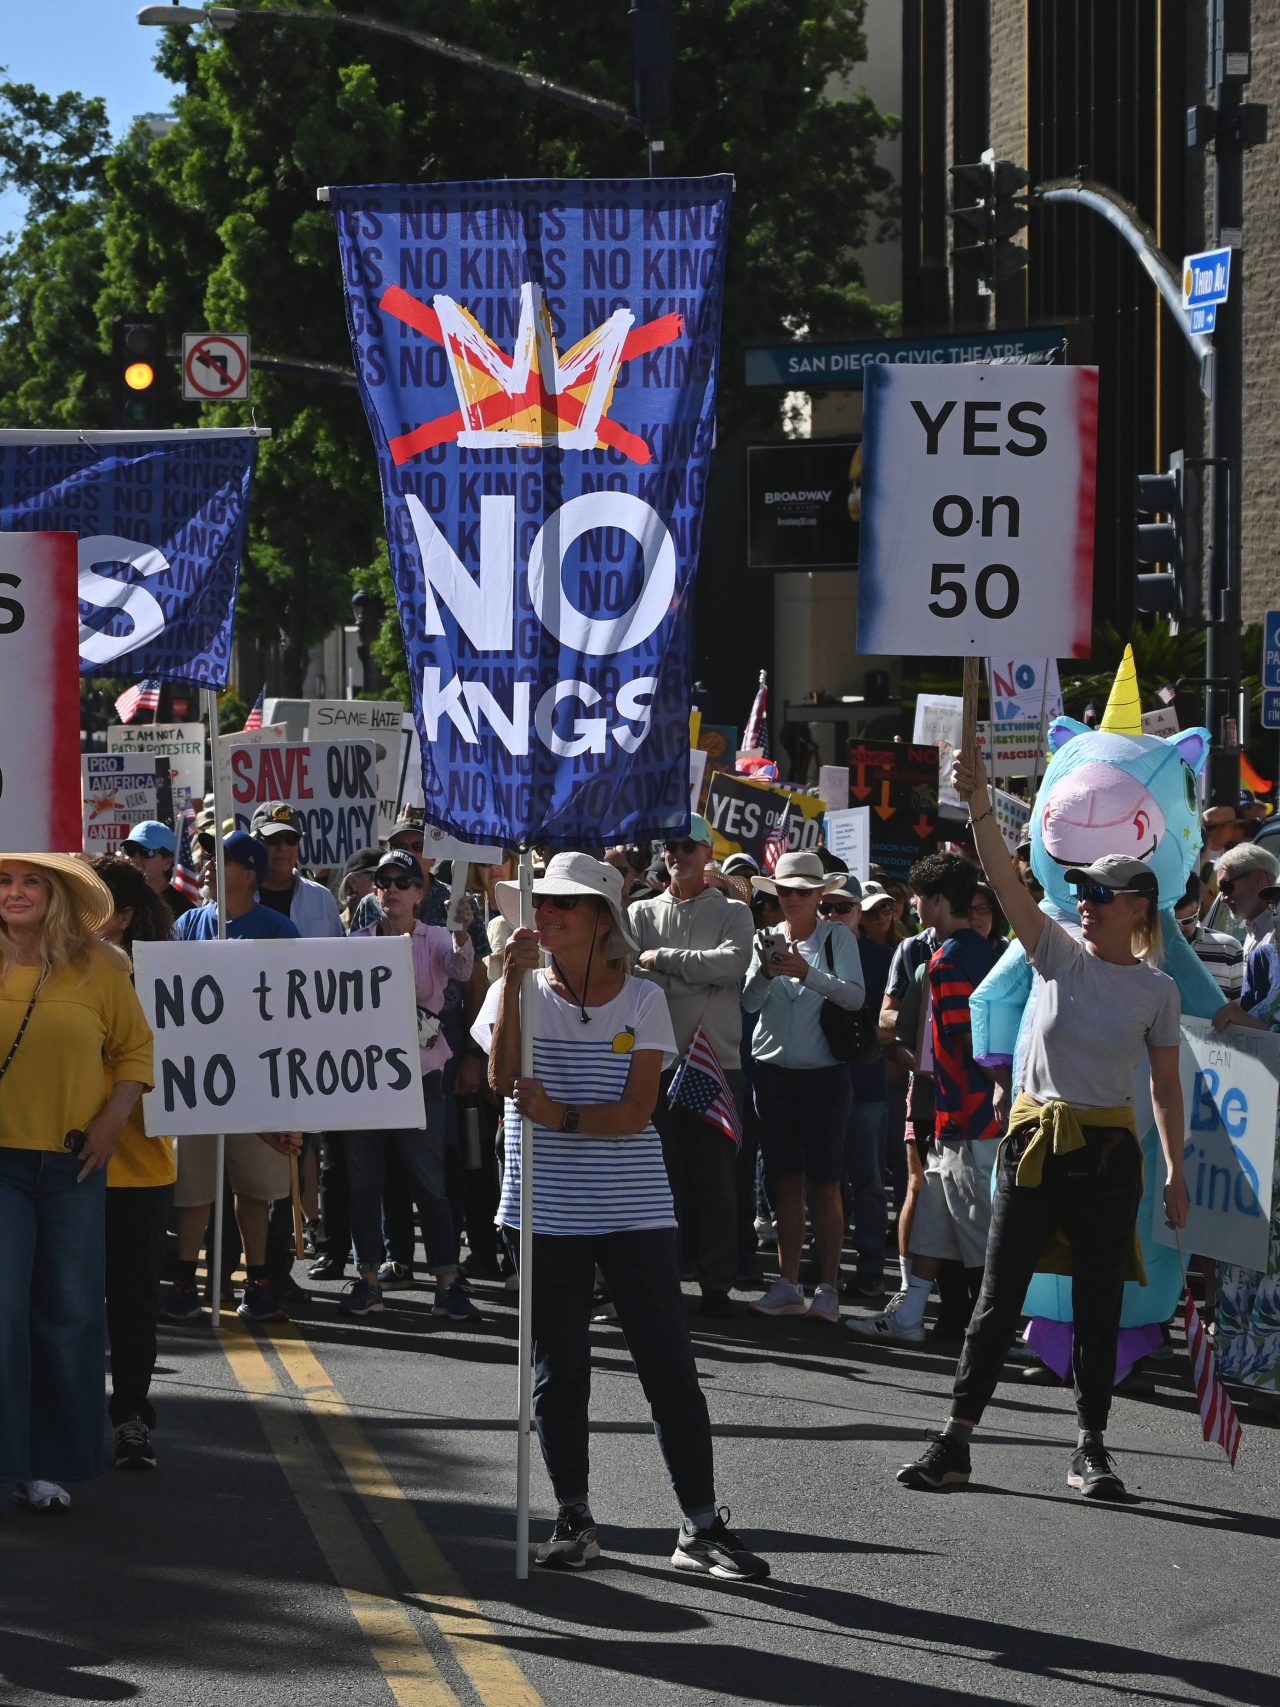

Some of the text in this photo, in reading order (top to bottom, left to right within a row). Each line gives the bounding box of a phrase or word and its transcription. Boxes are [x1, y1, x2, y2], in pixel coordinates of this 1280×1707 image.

[460, 200, 566, 241] KINGS
[583, 202, 631, 242] NO
[399, 247, 448, 289] NO
[583, 248, 631, 290] NO
[788, 357, 826, 374] SAN
[895, 346, 944, 366] CIVIC
[910, 400, 1048, 457] YES
[764, 490, 832, 505] BROADWAY
[932, 493, 1020, 537] on
[405, 491, 676, 656] NO
[928, 563, 1020, 619] 50
[993, 660, 1035, 697] NO
[137, 730, 153, 741] AM
[157, 729, 176, 740] NOT
[176, 728, 184, 740] A
[317, 708, 401, 727] SAME HATE
[89, 758, 117, 772] PRO
[91, 775, 156, 791] AMERICA
[231, 747, 314, 803] SAVE
[327, 745, 376, 799] OUR
[89, 826, 120, 839] ANTI
[711, 793, 761, 838] YES
[787, 814, 820, 850] 50
[155, 975, 224, 1029] NO
[161, 1044, 412, 1112] NO TROOPS
[1209, 1050, 1232, 1068] CAN
[1190, 1068, 1248, 1138] Be
